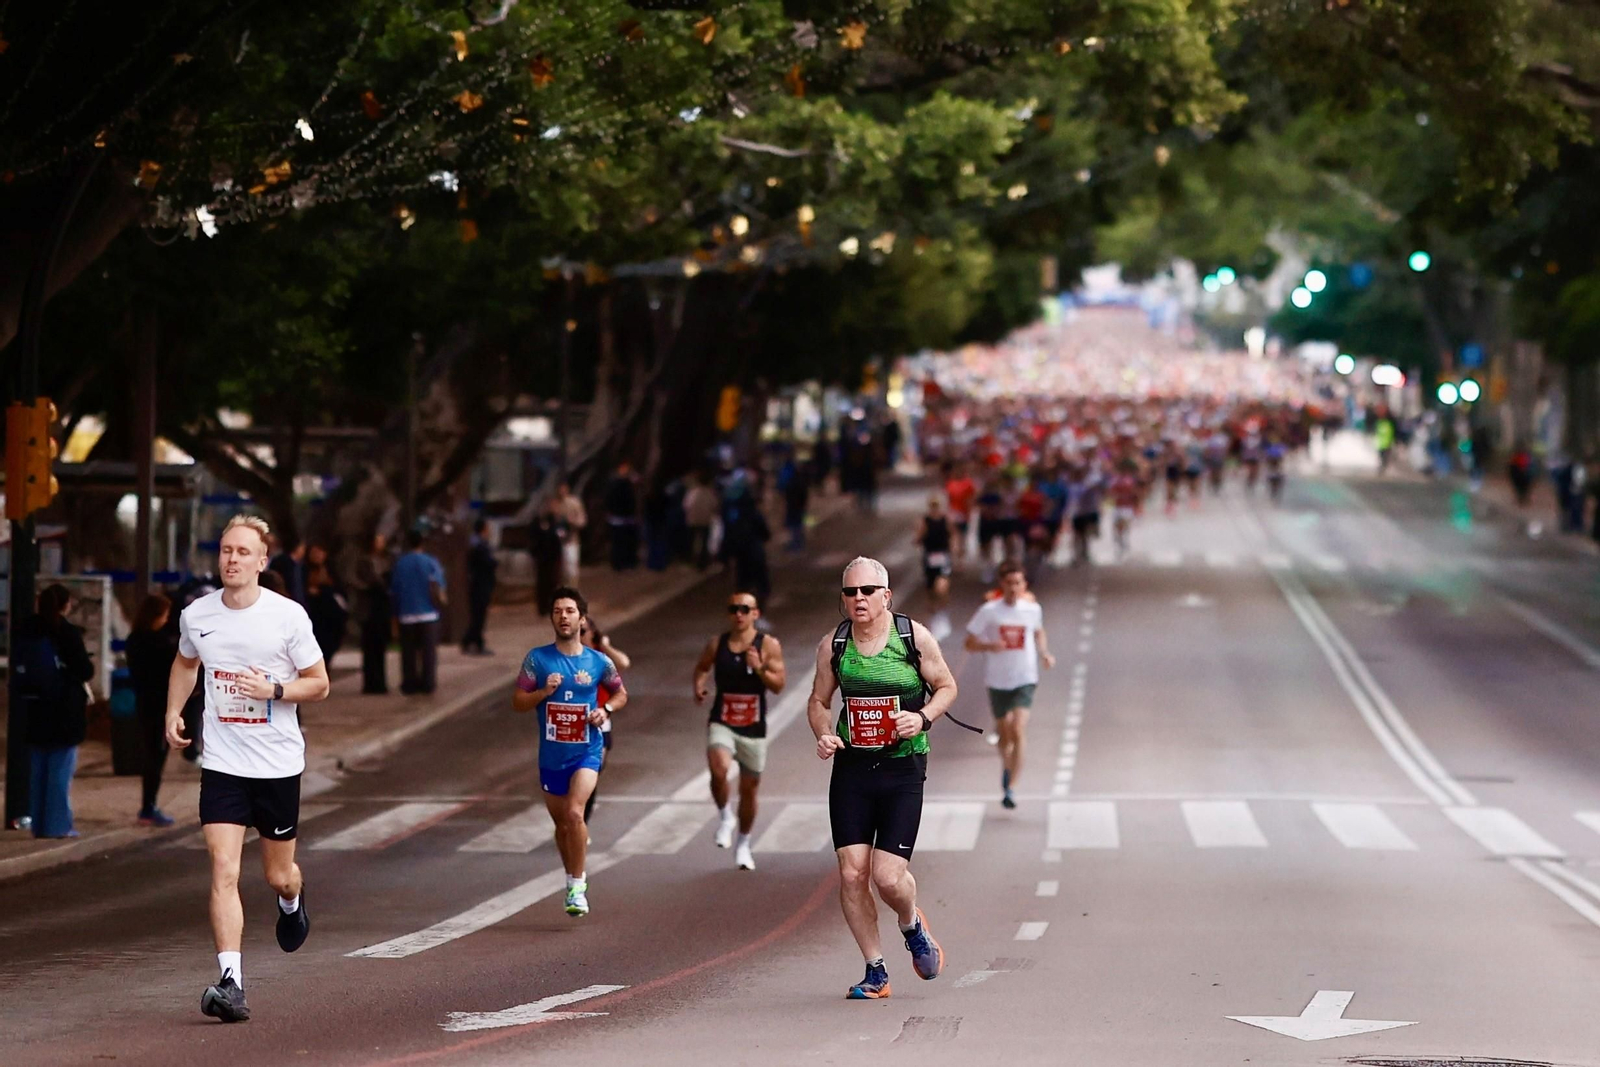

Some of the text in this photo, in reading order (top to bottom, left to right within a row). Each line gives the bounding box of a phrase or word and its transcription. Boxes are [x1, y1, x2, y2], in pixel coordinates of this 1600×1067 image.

[857, 698, 890, 707] GENERALI
[556, 713, 578, 722] 3539
[857, 710, 883, 720] 7660
